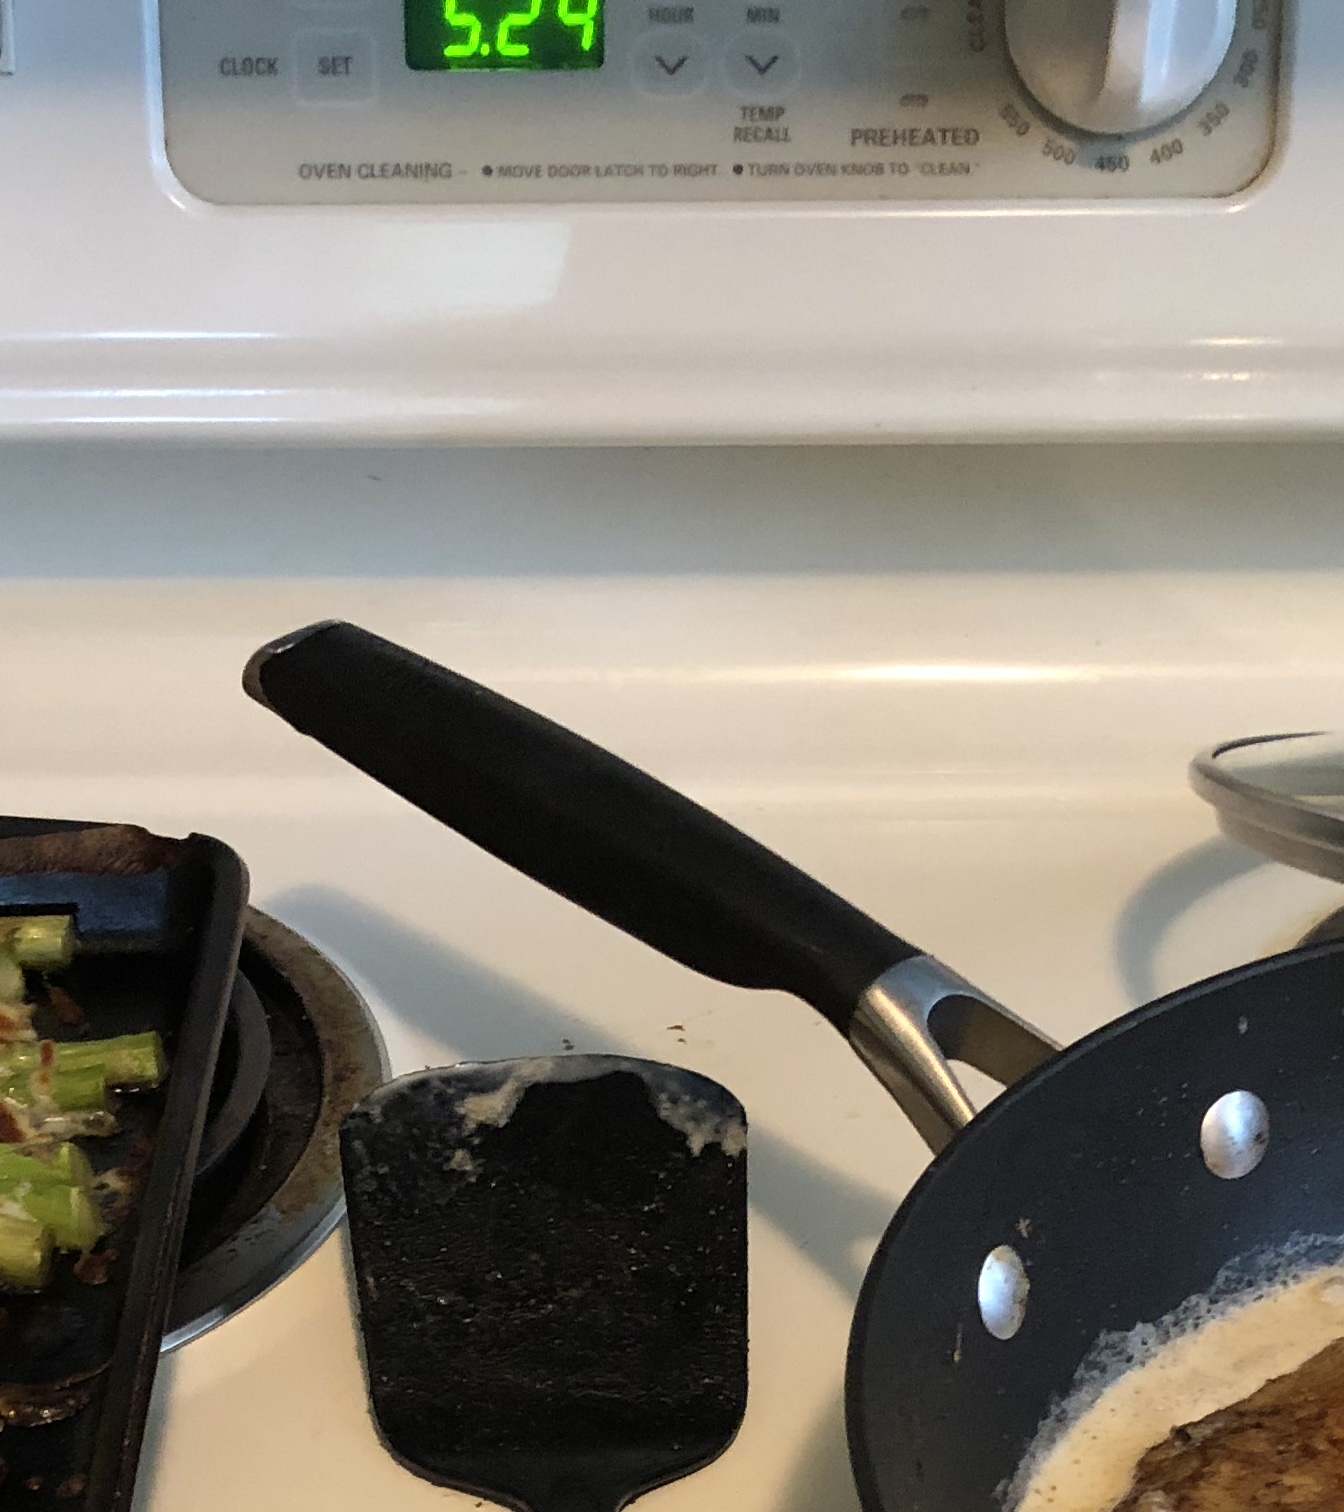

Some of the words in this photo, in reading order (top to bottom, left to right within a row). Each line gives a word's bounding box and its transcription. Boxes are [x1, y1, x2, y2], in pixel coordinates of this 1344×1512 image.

[219, 57, 278, 77] CLOCK
[317, 57, 352, 76] SET
[740, 106, 786, 122] TEMP
[733, 127, 791, 143] RECALL
[851, 128, 981, 147] PREHEATED
[1043, 138, 1076, 165] 500
[1150, 138, 1183, 164] 400
[298, 163, 351, 180] OVEN
[357, 162, 453, 180] CLEANING
[497, 164, 542, 178] MOVE
[547, 164, 591, 178] DOOR
[595, 163, 645, 178] LATCH
[648, 163, 669, 178] TO
[673, 163, 718, 177] RIGHT
[748, 162, 790, 177] TURN
[794, 162, 837, 177] OVEN
[889, 162, 910, 176] TO
